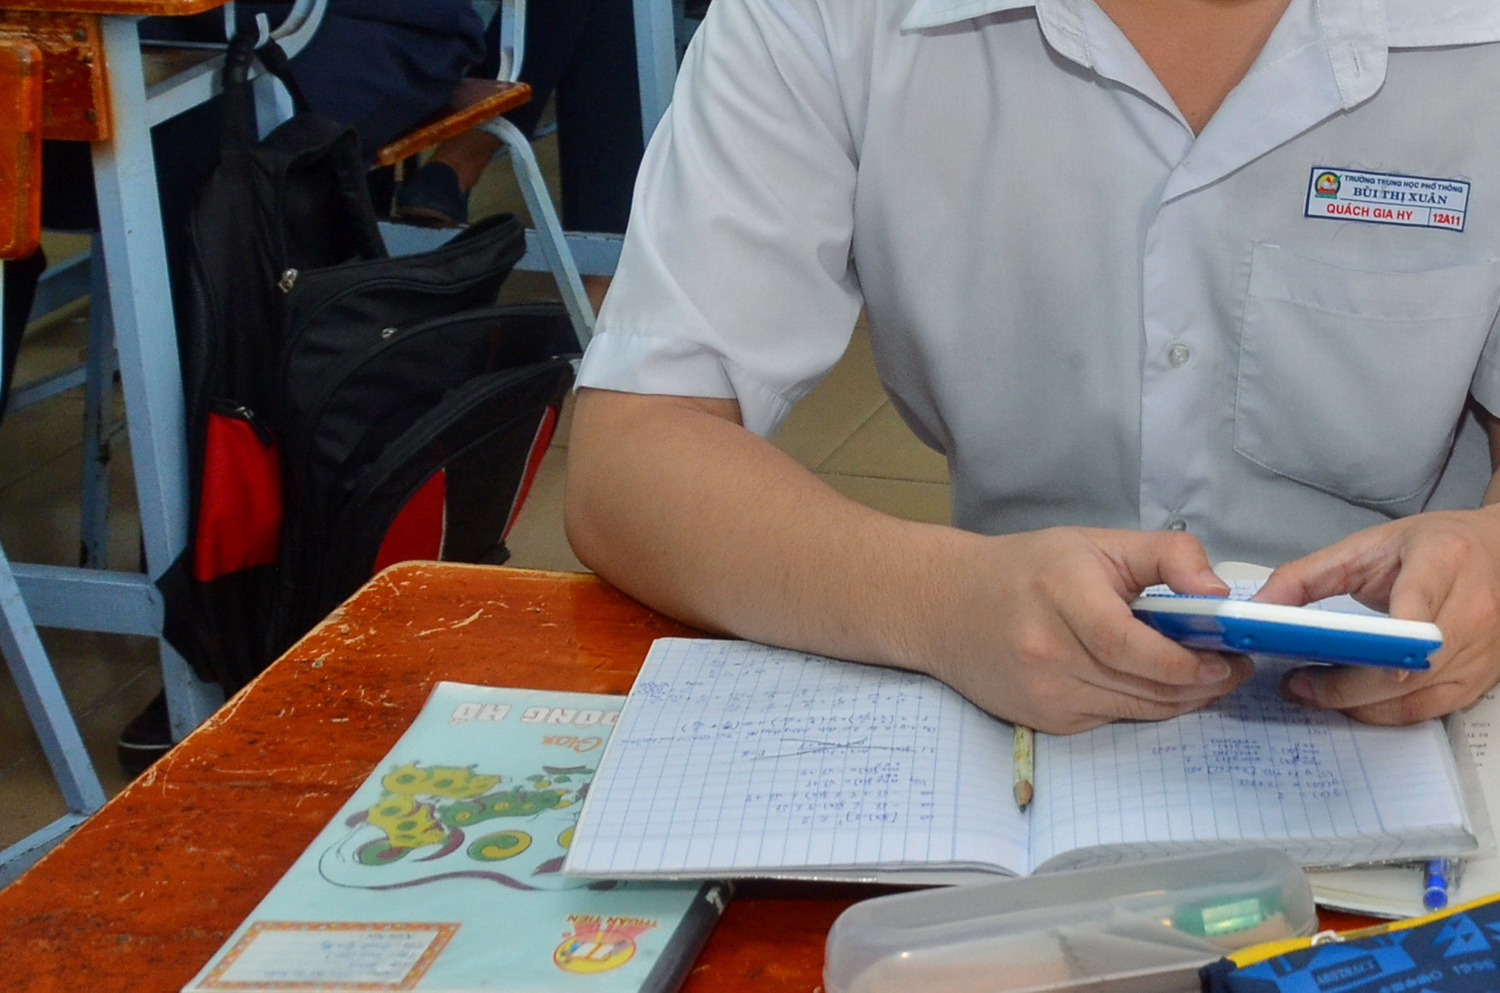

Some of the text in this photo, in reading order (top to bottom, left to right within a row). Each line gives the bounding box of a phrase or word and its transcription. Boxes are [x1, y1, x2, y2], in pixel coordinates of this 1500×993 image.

[1344, 174, 1464, 194] TRƯỜNG TRUNG HỌC PHỔ THÔNG
[1353, 185, 1448, 205] BÙI THỊ XUÂN
[1326, 203, 1461, 226] QUÁCH GIA HY 12A11
